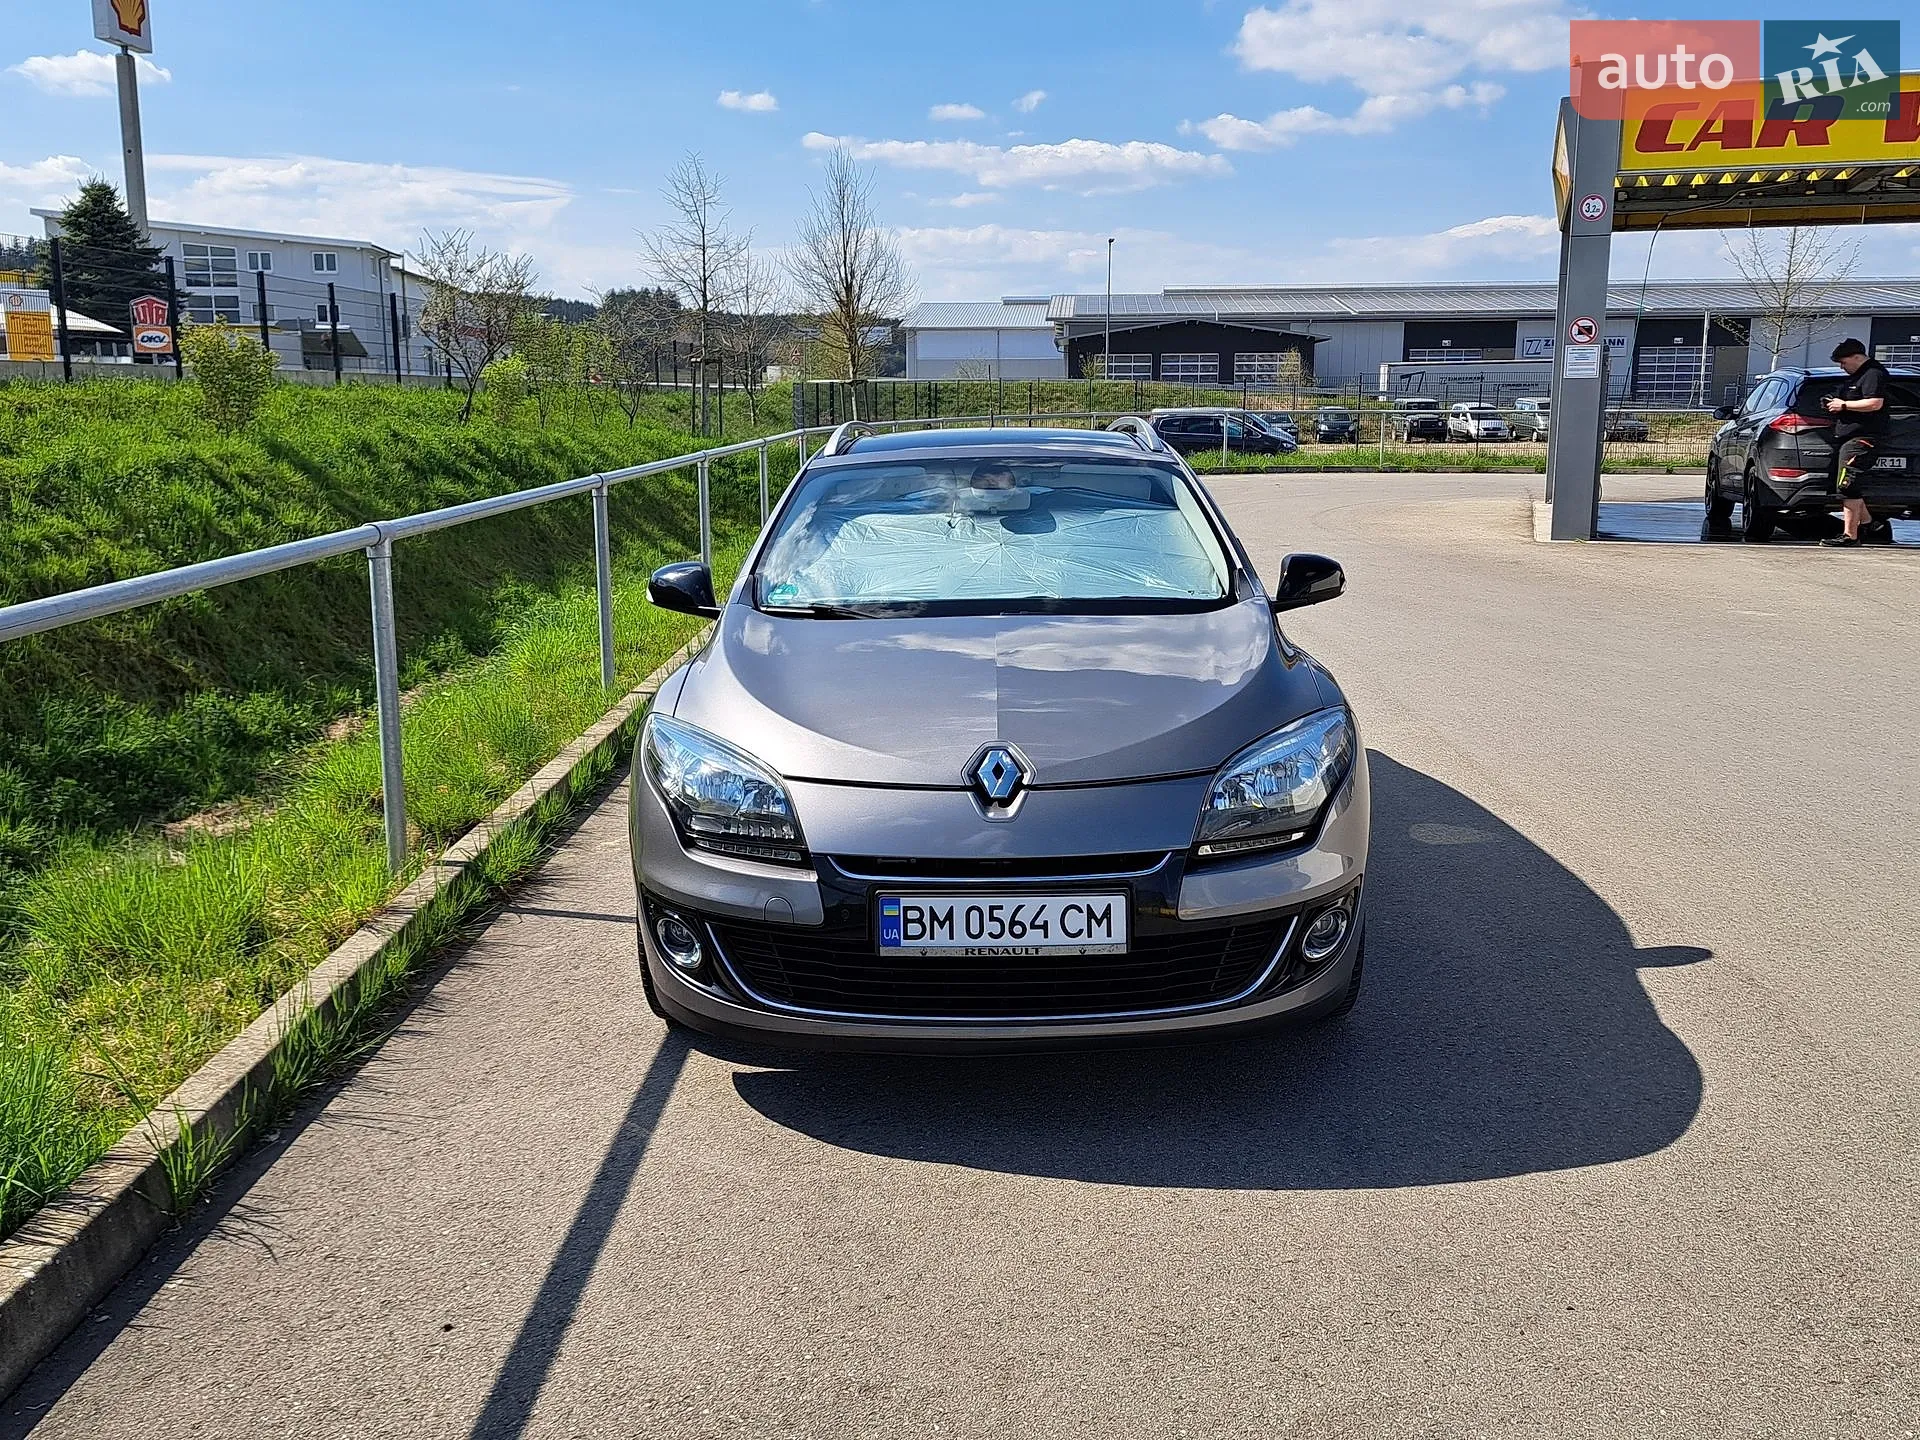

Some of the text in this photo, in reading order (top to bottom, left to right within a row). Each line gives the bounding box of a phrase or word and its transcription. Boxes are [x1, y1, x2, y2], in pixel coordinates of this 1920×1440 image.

[1634, 95, 1846, 153] CAR
[902, 903, 1112, 940] BM 0564 CM
[884, 929, 899, 939] UA
[964, 947, 1042, 956] RENAULT
